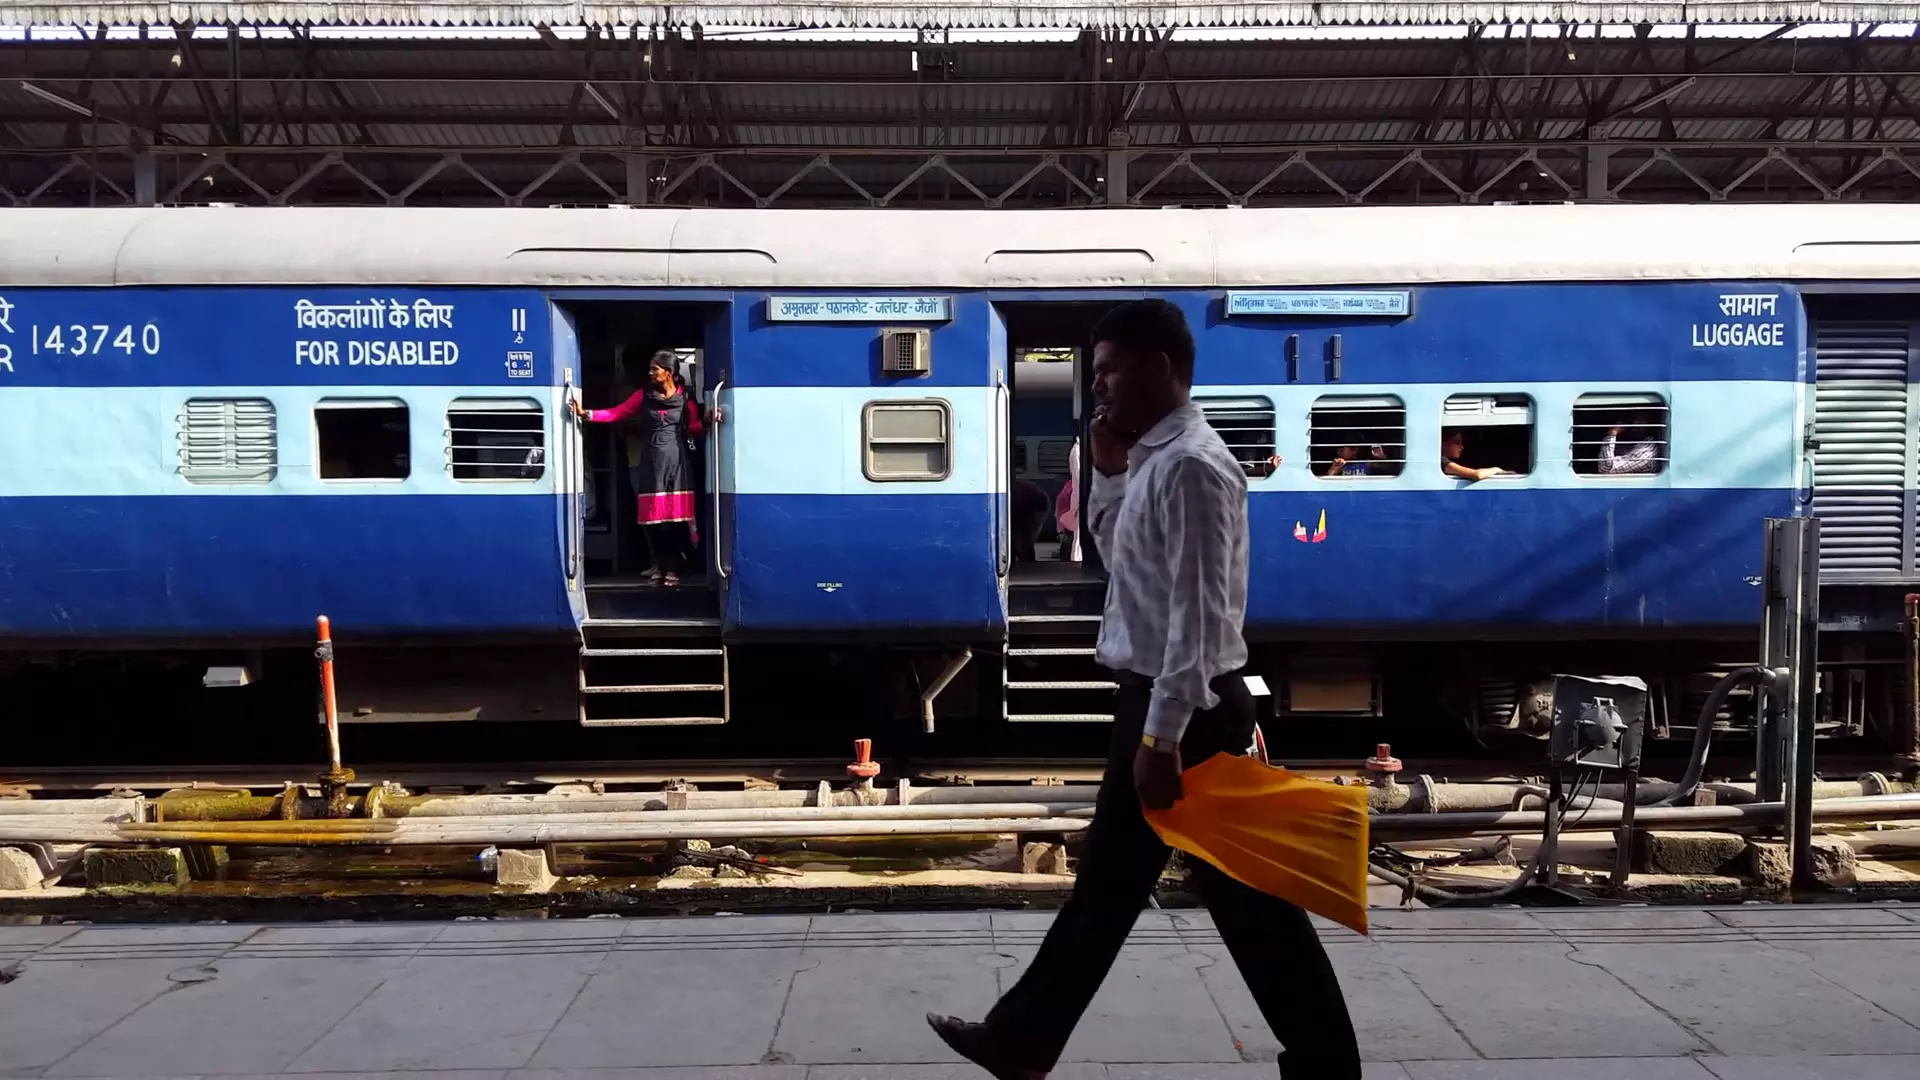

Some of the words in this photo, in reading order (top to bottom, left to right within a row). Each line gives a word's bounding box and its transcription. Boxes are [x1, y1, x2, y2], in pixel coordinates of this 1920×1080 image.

[294, 298, 386, 328] विकलांगों
[388, 298, 410, 328] के
[412, 298, 454, 328] लिए
[781, 302, 819, 317] अमृतसर
[826, 298, 868, 314] पठानकोट
[875, 299, 908, 314] जलंधर
[1719, 294, 1779, 316] सामान
[32, 324, 161, 356] 143740
[1692, 323, 1785, 346] LUGGAGE
[295, 341, 340, 365] FOR
[349, 341, 459, 365] DISABLED
